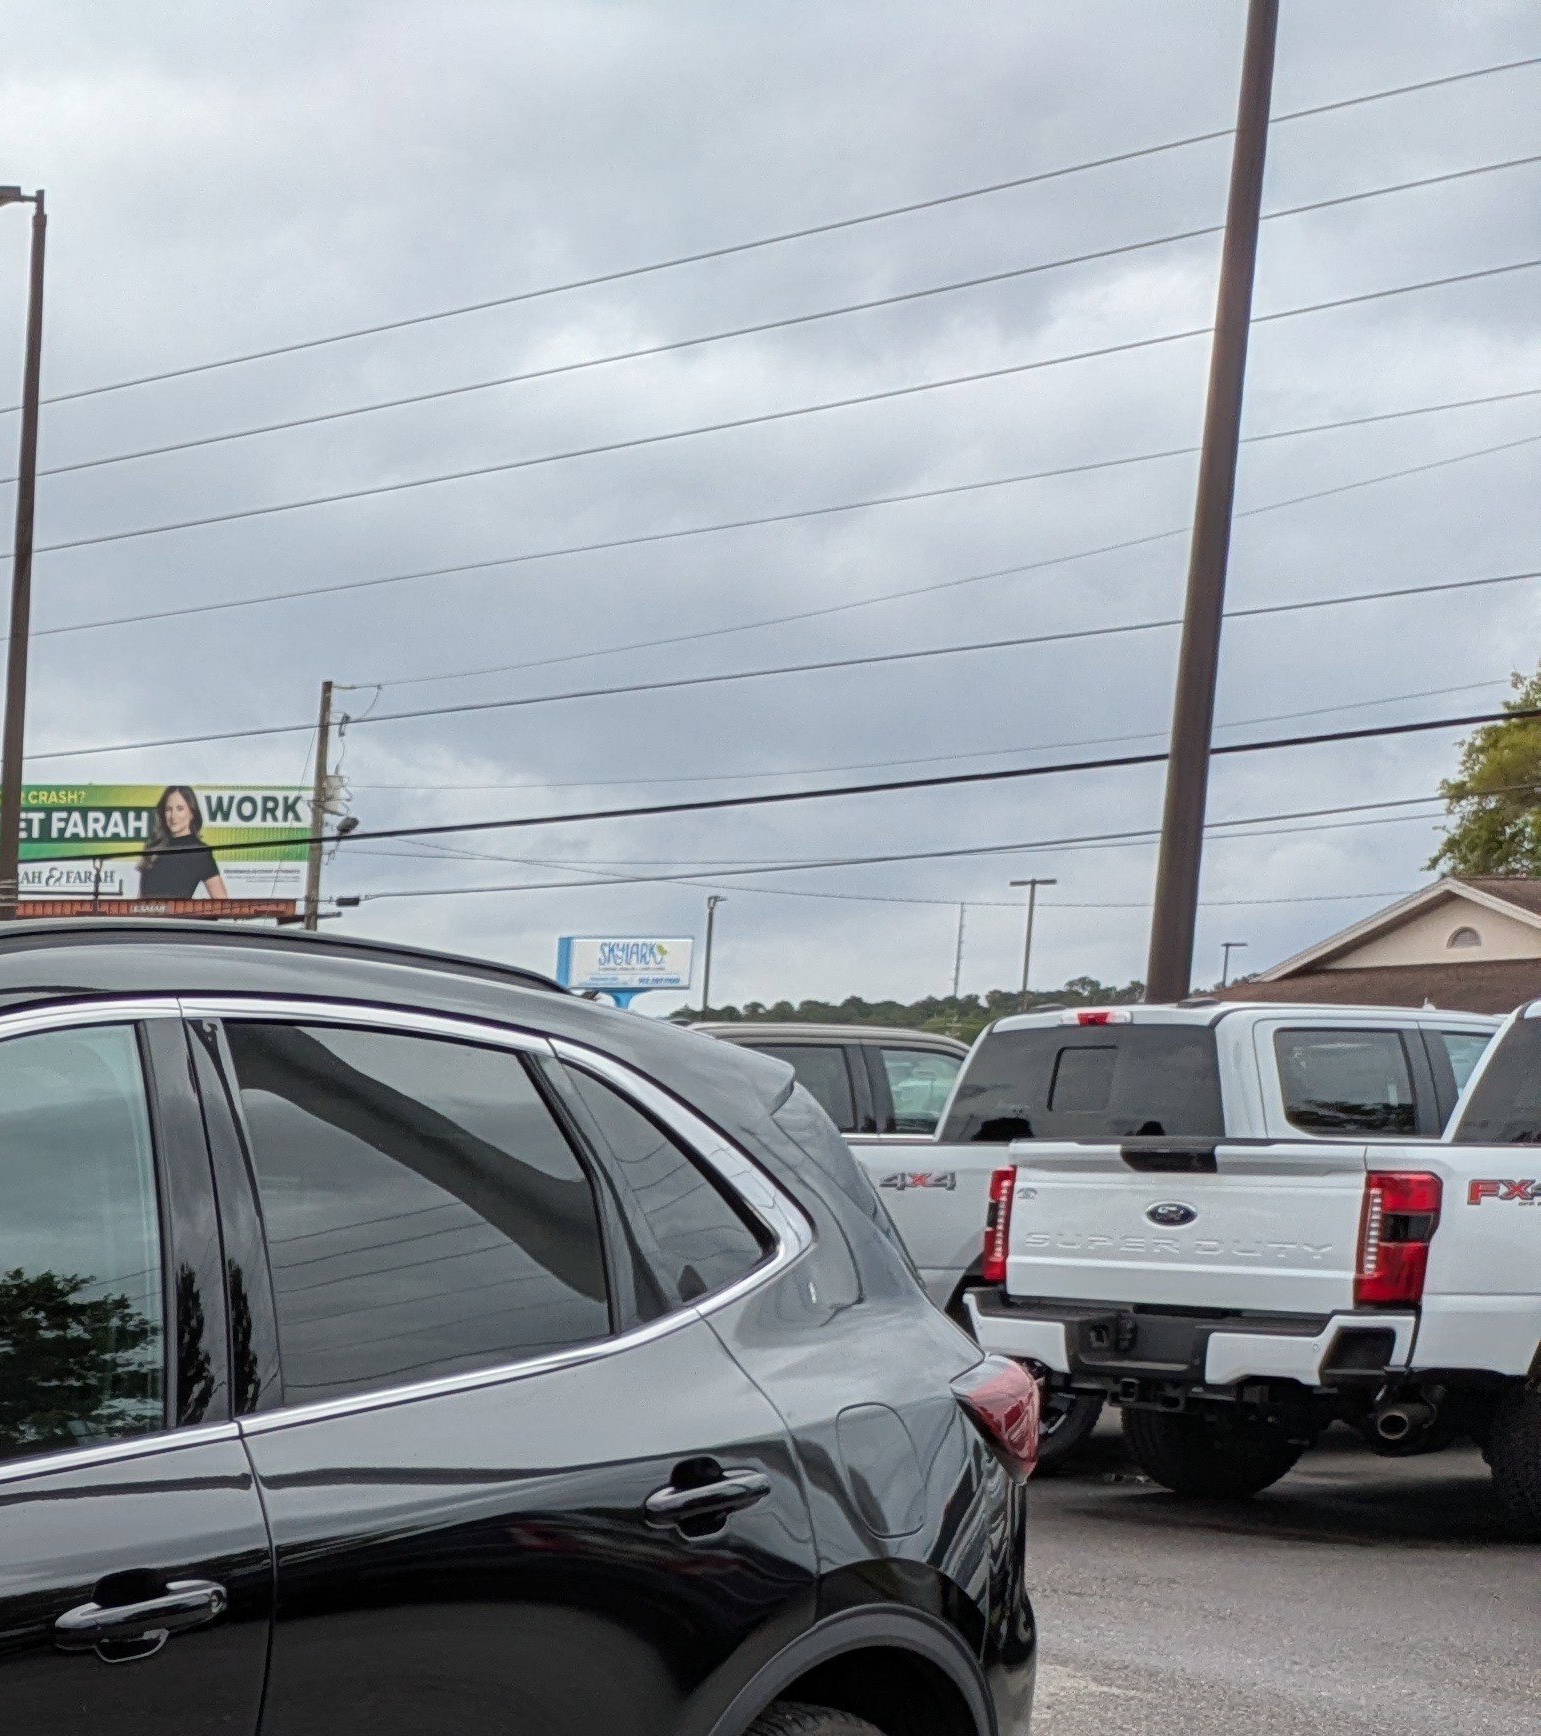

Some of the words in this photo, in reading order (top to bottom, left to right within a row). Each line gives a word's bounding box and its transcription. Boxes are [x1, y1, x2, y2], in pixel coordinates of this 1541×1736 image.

[28, 790, 86, 804] CRASH?
[204, 795, 302, 822] WORK
[50, 811, 149, 838] FARAH
[1467, 1179, 1541, 1205] FX
[1024, 1233, 1180, 1253] SUPER
[1193, 1239, 1333, 1259] DUTY
